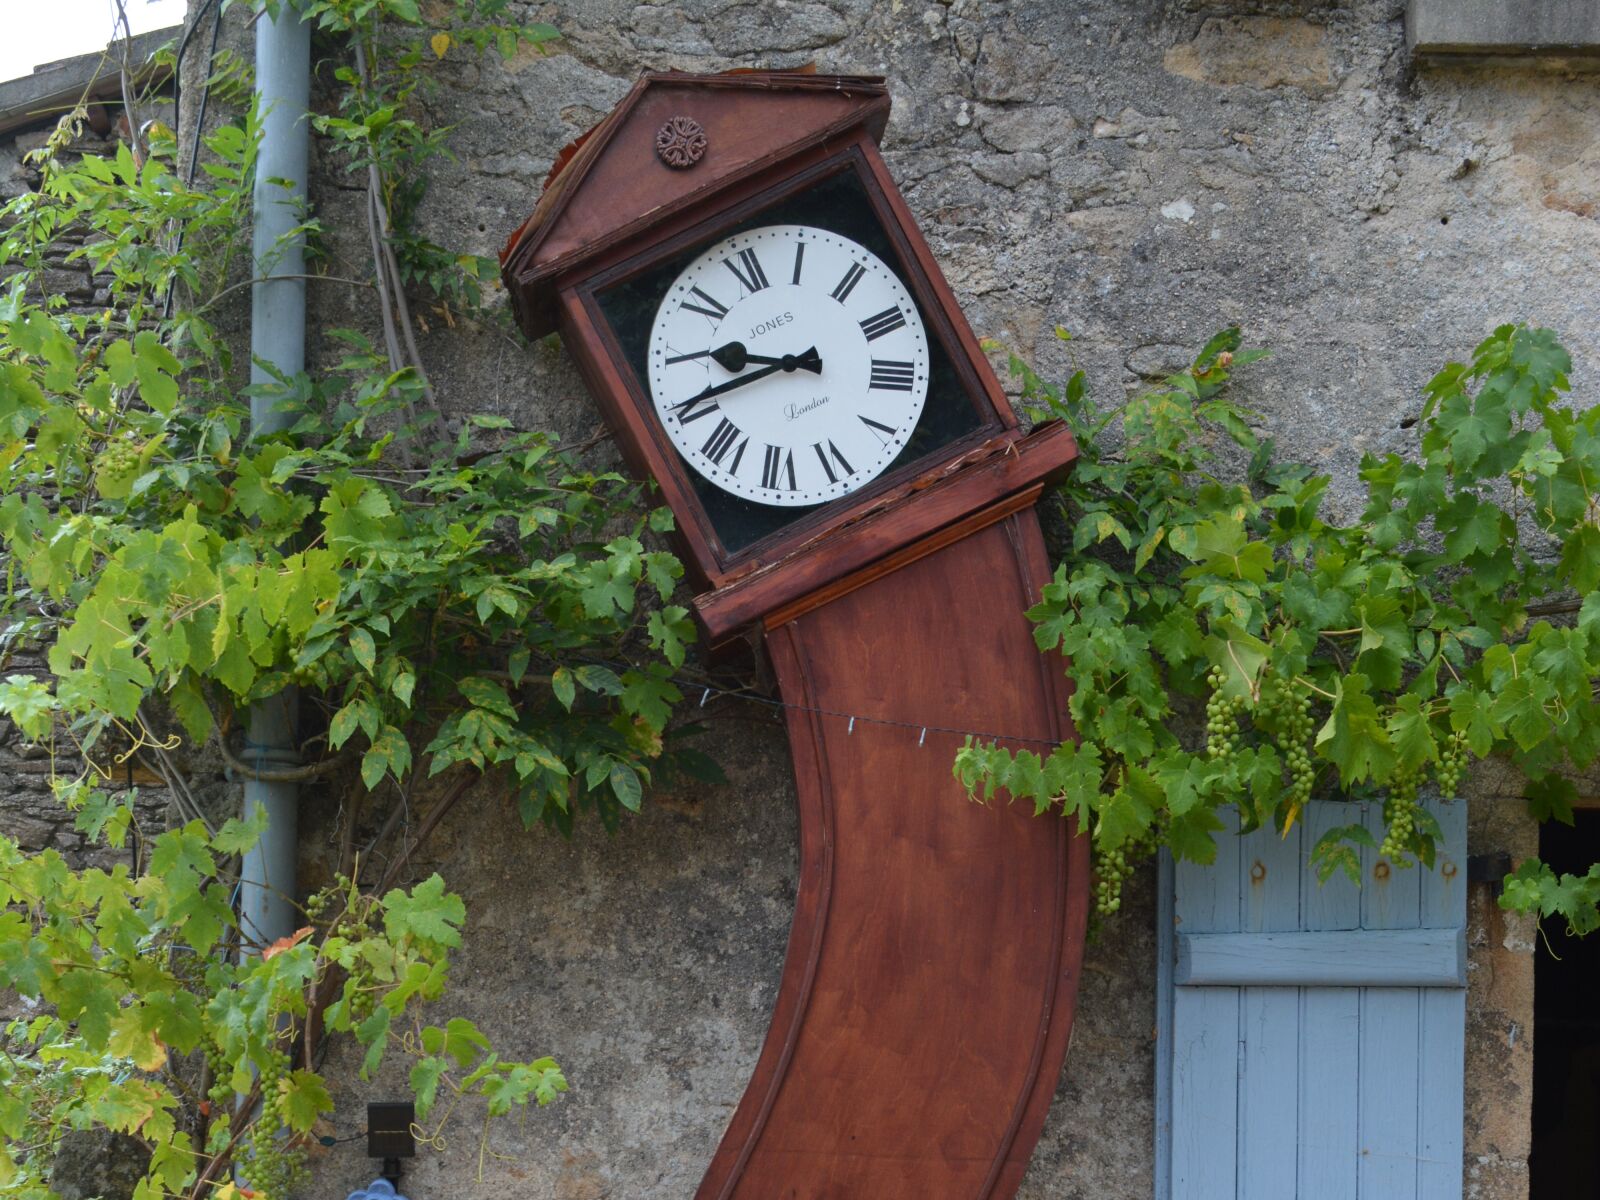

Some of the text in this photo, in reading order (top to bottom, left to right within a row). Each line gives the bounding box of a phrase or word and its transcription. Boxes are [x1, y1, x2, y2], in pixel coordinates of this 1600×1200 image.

[719, 247, 773, 301] XII
[787, 241, 809, 286] I
[828, 259, 871, 307] II
[677, 282, 733, 337] XI
[749, 311, 794, 340] JONES
[858, 302, 909, 344] III
[664, 341, 711, 374] X
[867, 357, 915, 393] IIII
[783, 395, 831, 422] London
[698, 415, 751, 478] VIII
[857, 415, 900, 450] V
[758, 442, 801, 491] VII
[810, 438, 859, 486] VI
